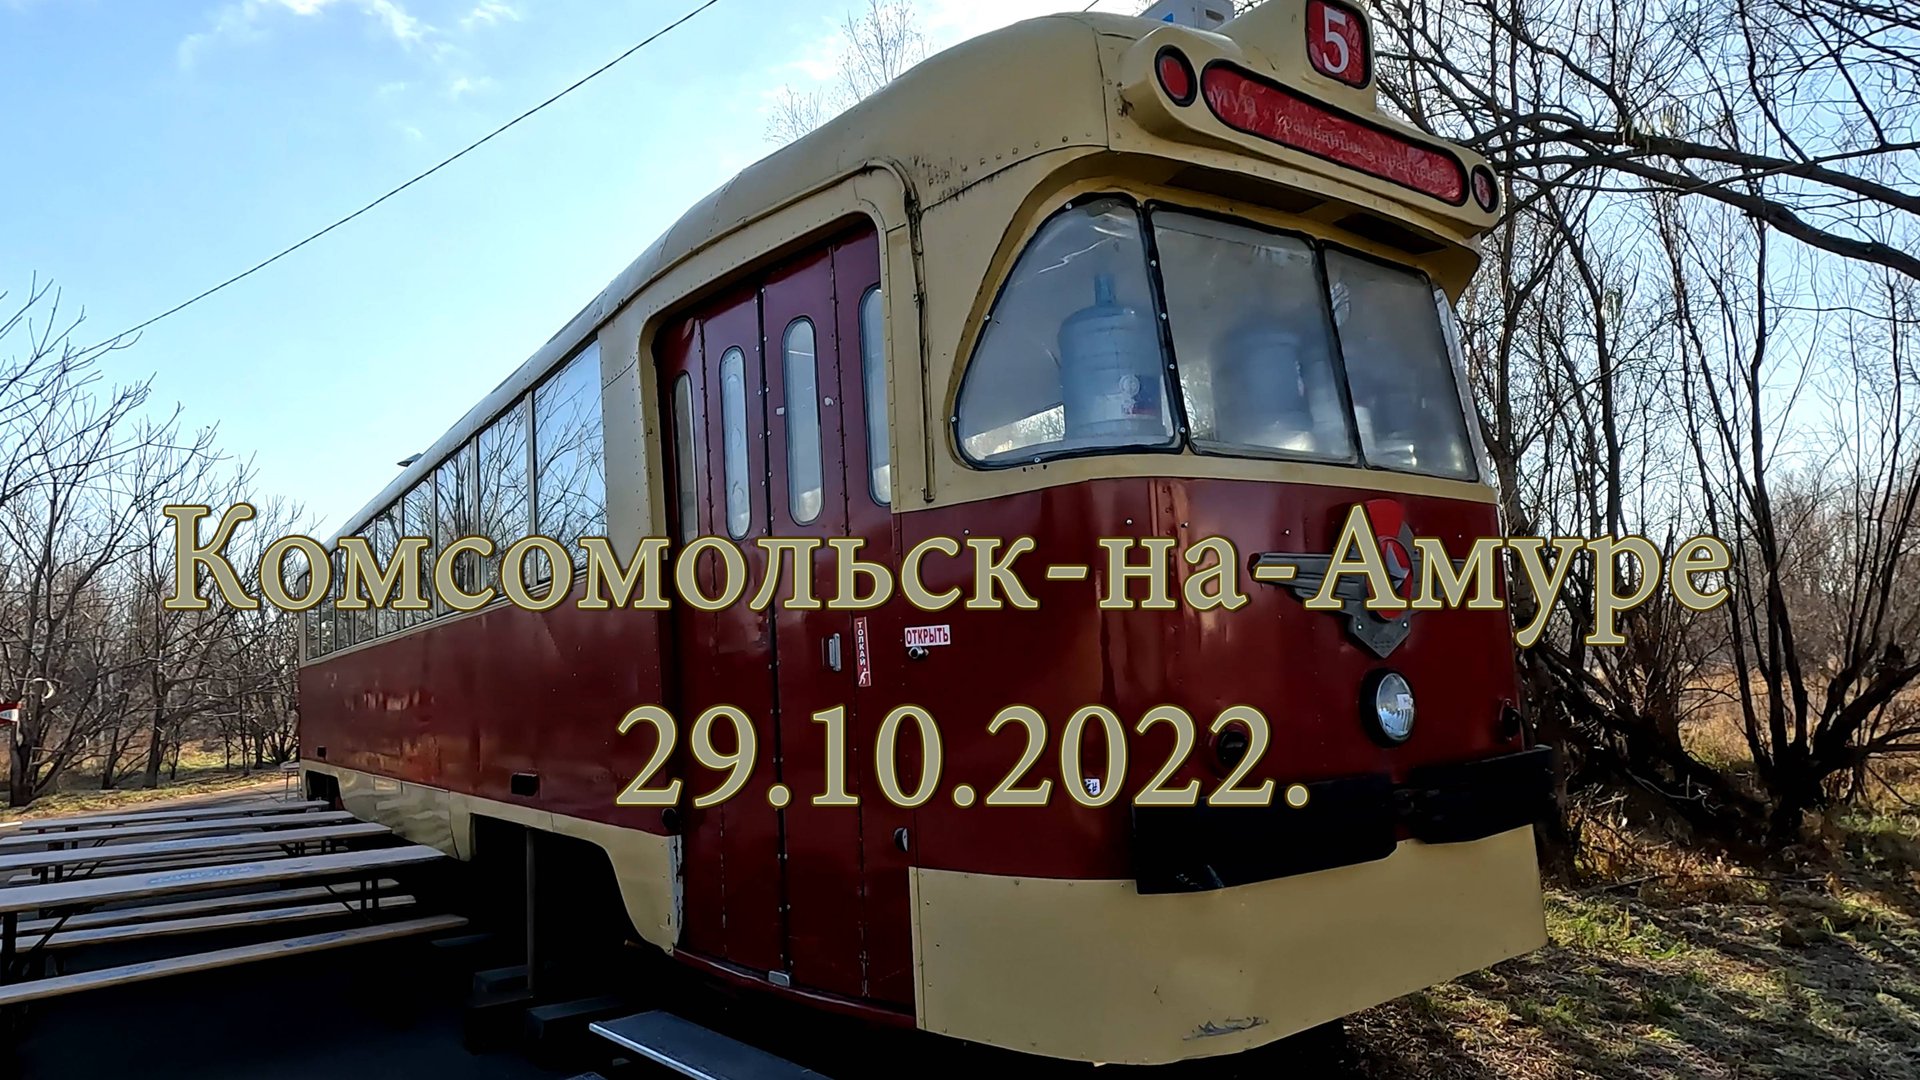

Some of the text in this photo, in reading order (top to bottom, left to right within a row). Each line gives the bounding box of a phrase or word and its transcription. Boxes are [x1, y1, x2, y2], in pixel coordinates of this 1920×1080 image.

[1323, 6, 1349, 73] 5
[856, 621, 866, 665] ТОЛКАЙ
[906, 628, 949, 645] ОТКРЫТЬ
